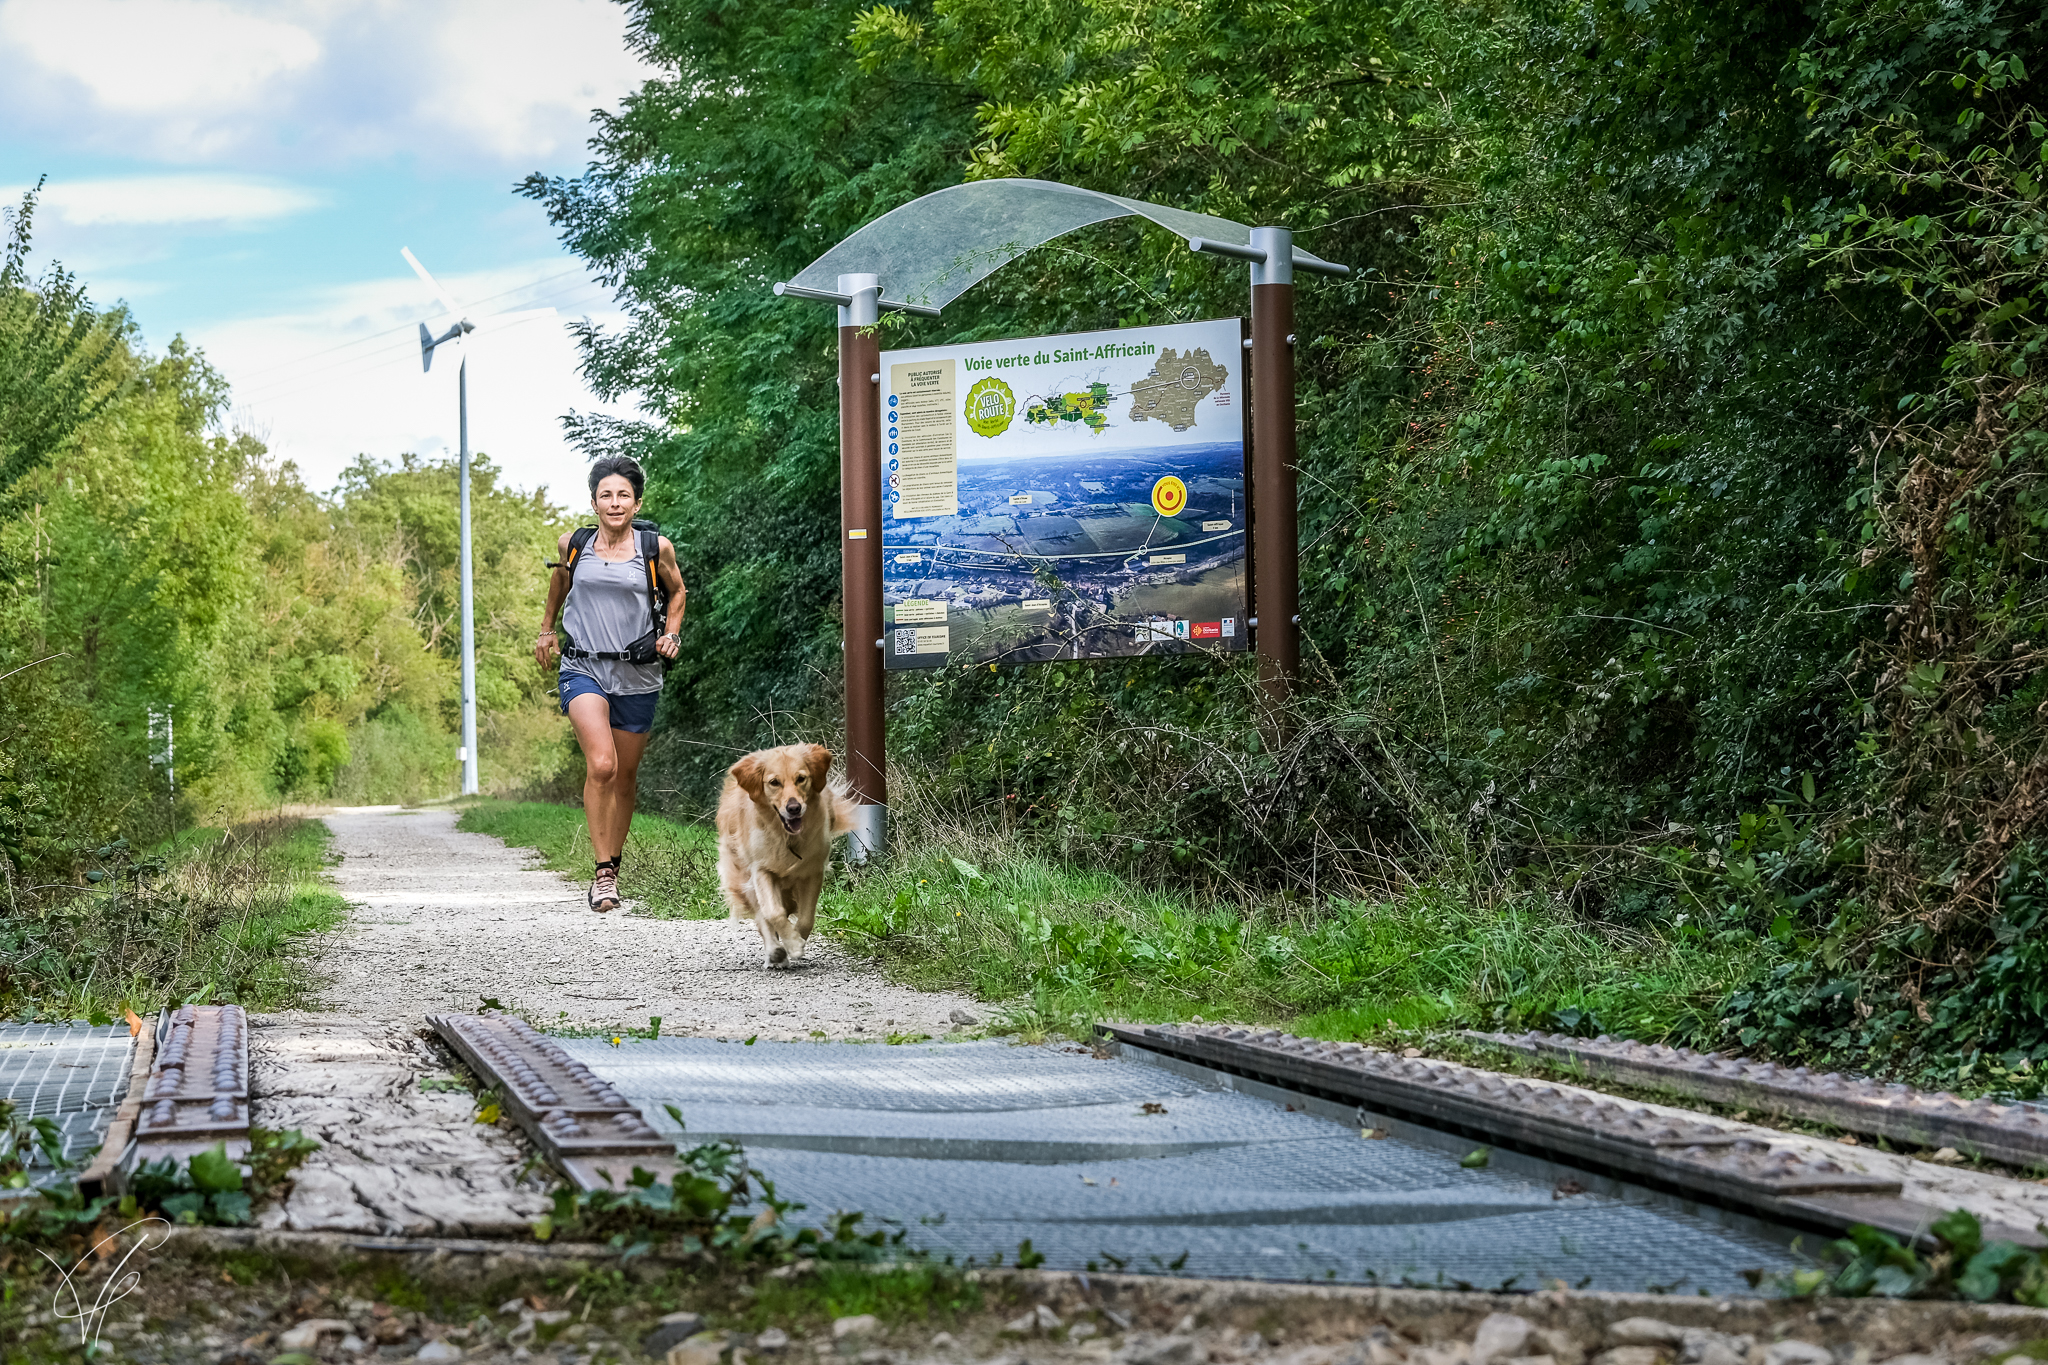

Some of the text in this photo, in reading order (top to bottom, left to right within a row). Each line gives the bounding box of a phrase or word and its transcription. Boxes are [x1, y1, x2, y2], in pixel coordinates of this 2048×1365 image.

[964, 341, 1156, 371] Voie verte du Saint-Affricain
[980, 393, 1000, 408] VELO
[978, 403, 1005, 420] ROUTE
